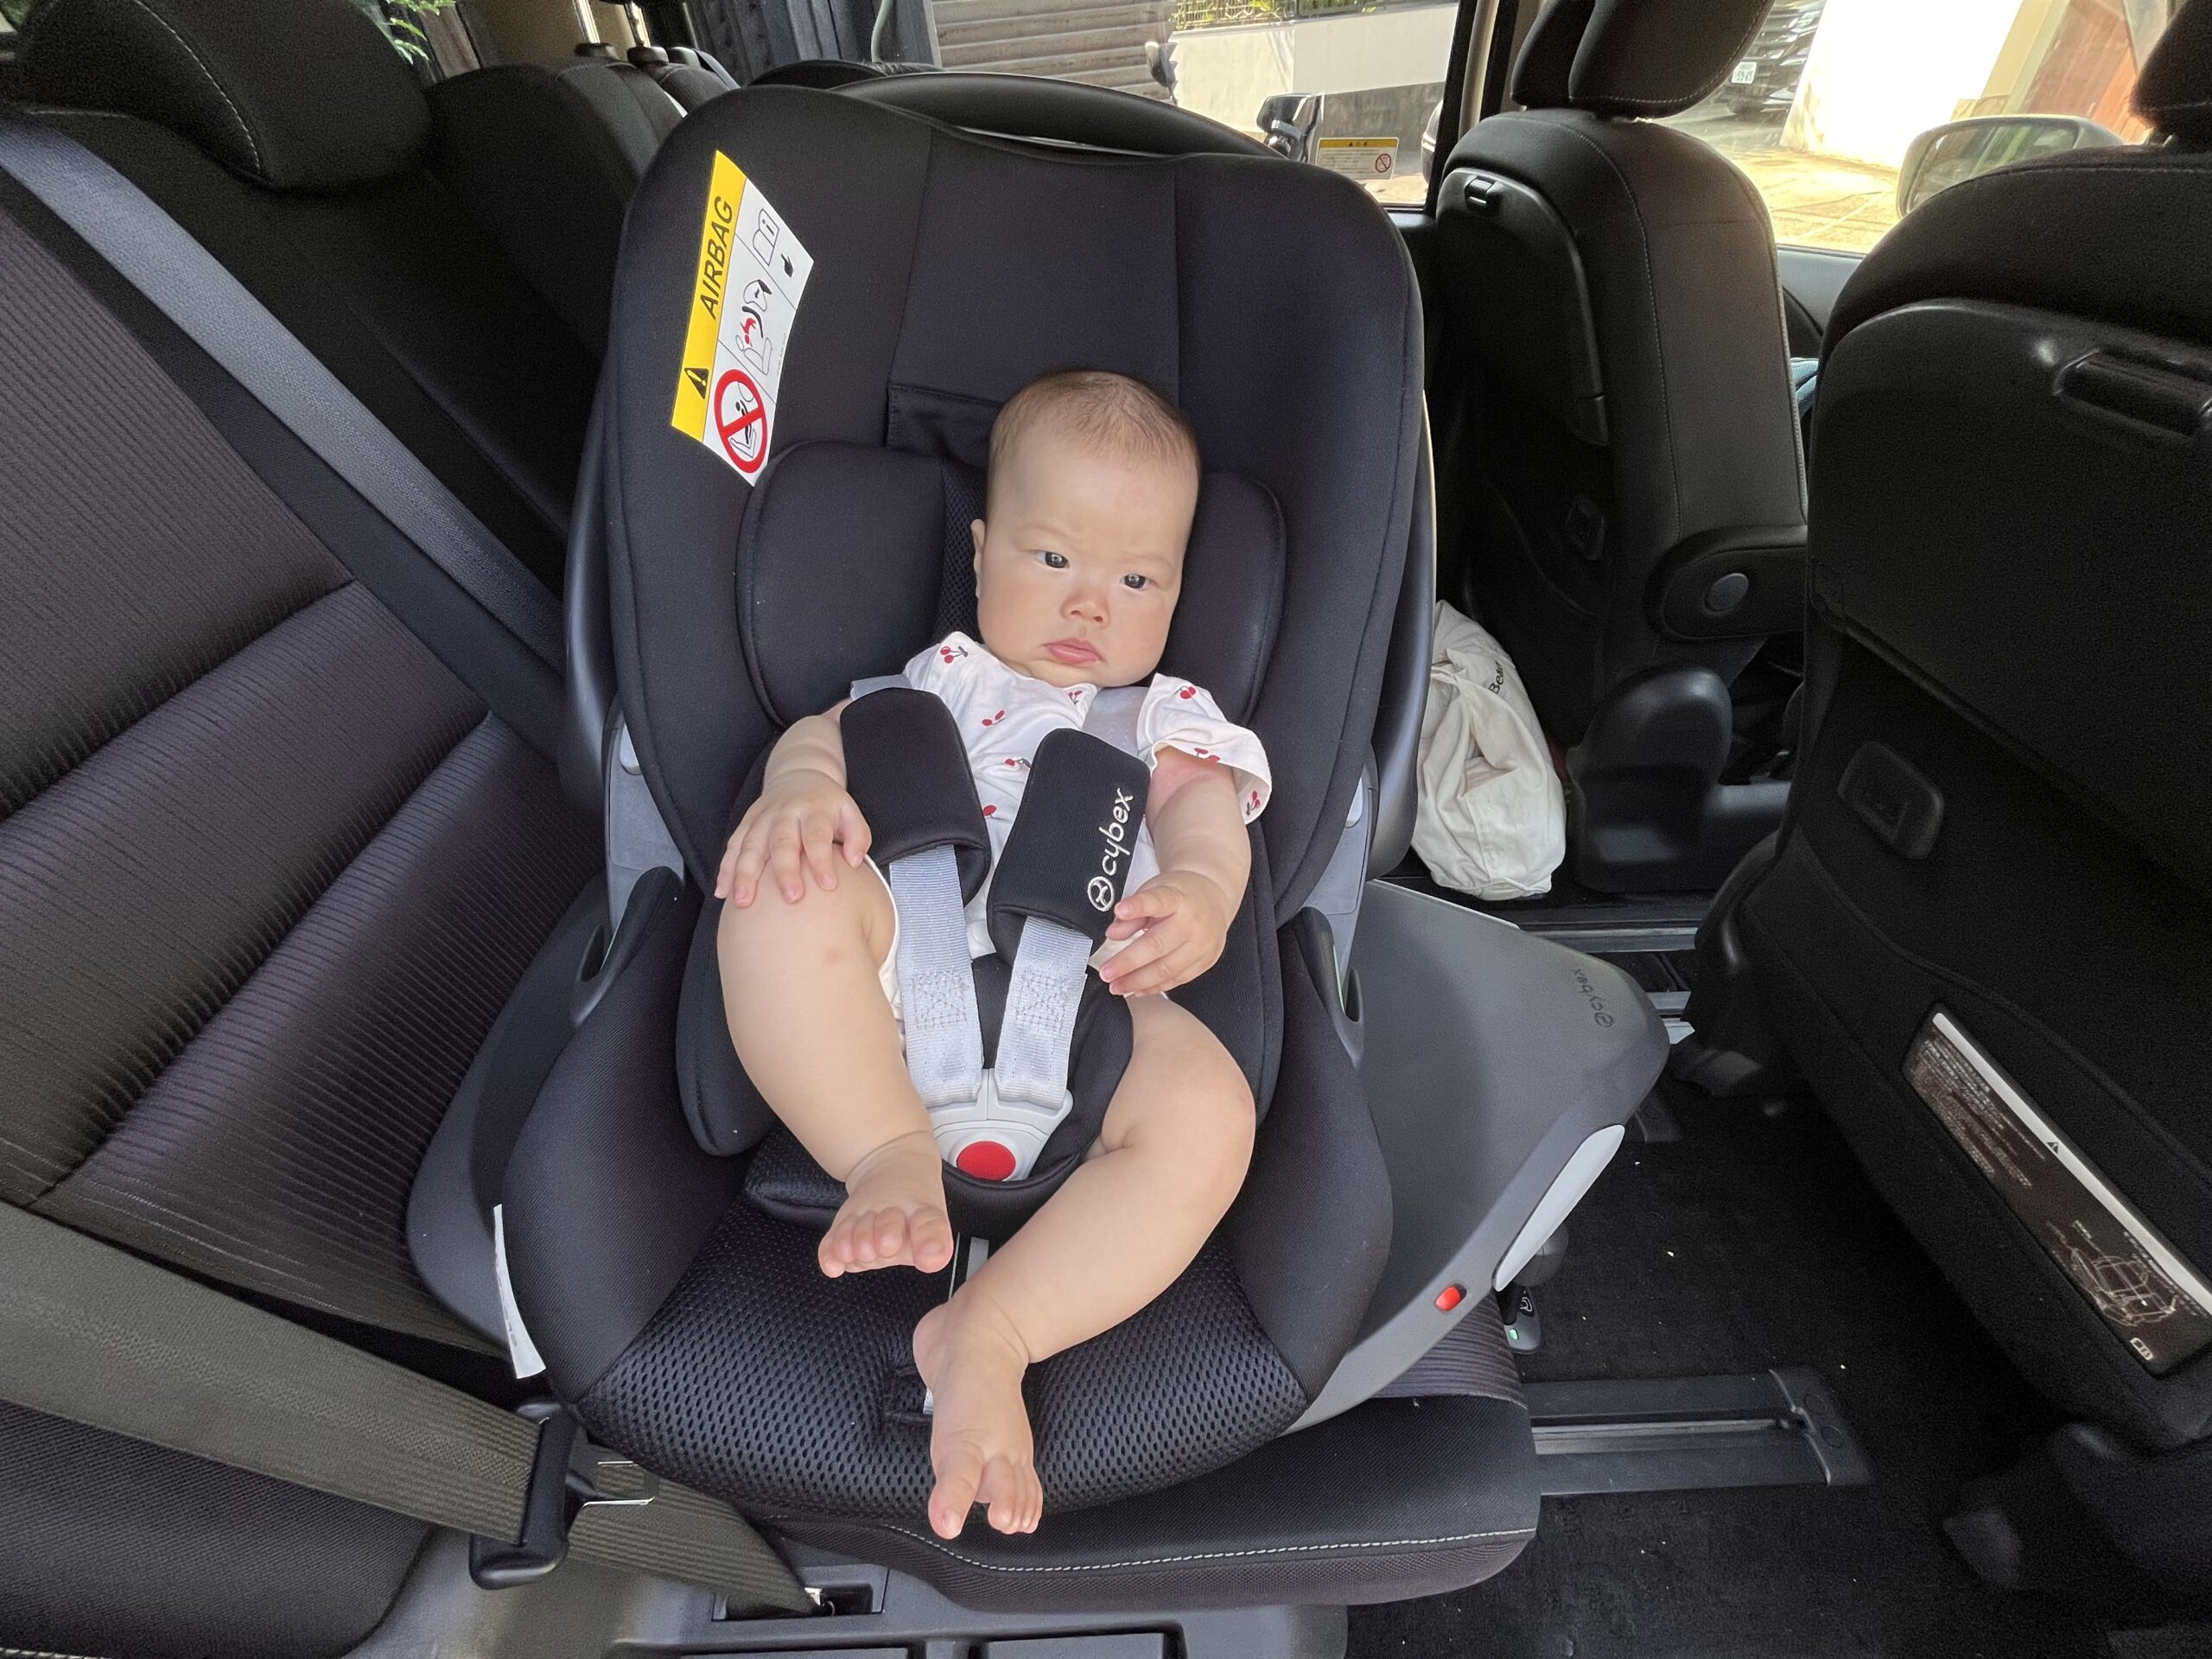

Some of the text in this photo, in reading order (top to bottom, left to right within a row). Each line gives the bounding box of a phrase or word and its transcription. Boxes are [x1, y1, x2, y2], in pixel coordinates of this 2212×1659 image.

[701, 195, 733, 321] AIRBAG
[1099, 787, 1134, 876] cybex
[1570, 969, 1609, 1011] cybex
